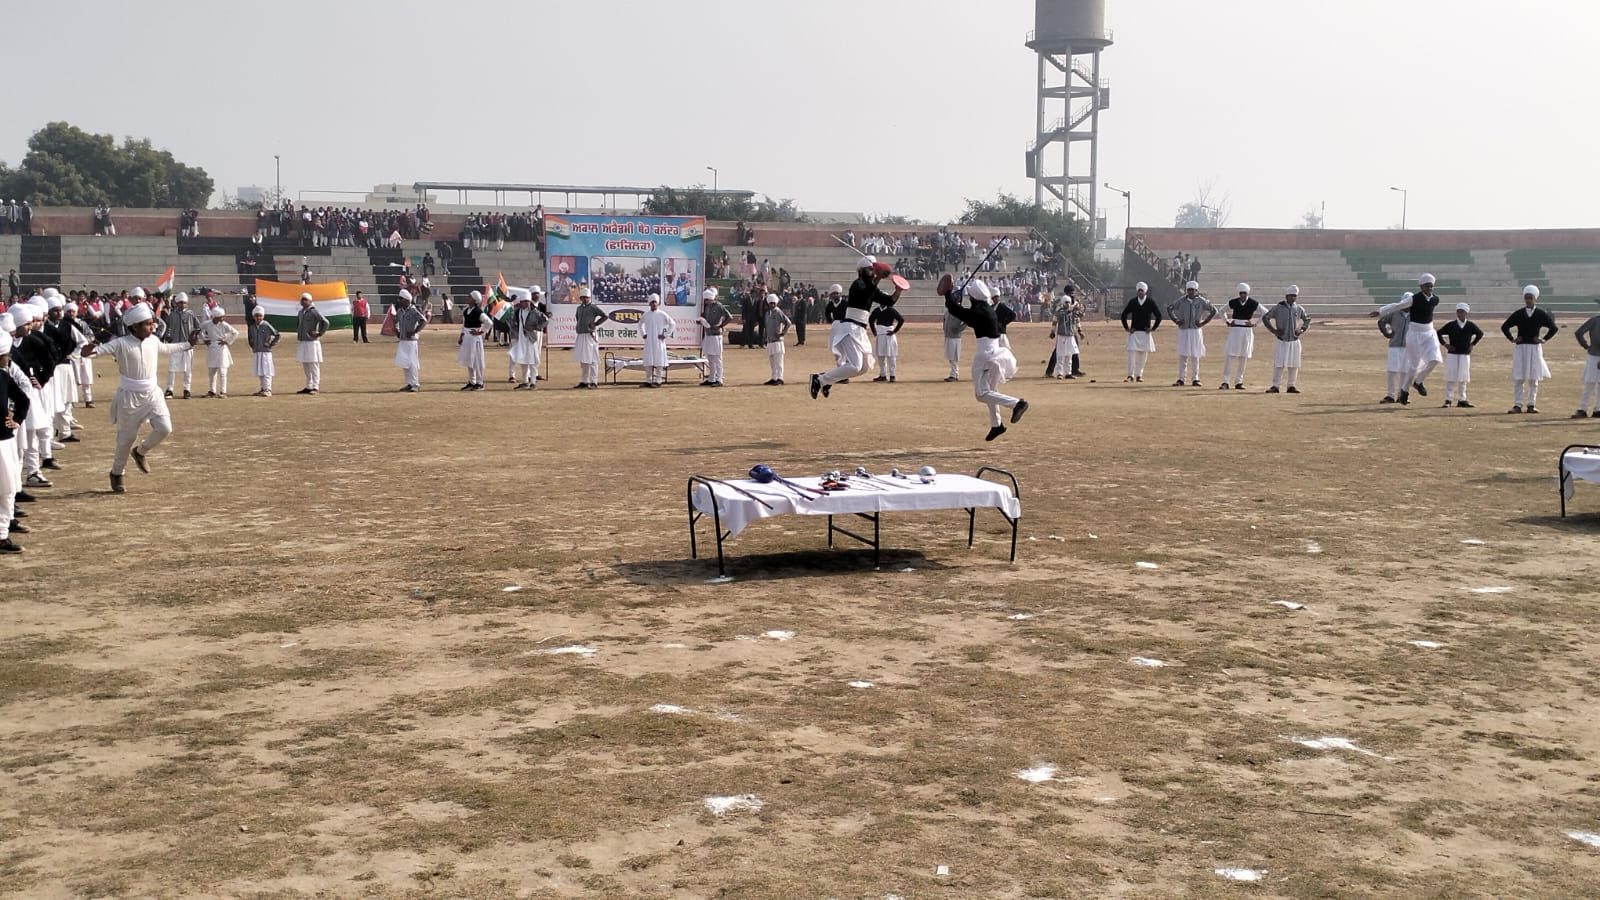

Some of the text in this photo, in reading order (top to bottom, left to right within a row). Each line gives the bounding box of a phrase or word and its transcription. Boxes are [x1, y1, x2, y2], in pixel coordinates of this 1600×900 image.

[572, 223, 598, 233] ਅਕਾਲ
[602, 220, 634, 235] ਅਕੈਡਮੀ
[653, 222, 679, 236] ਕਲੰਦਰ
